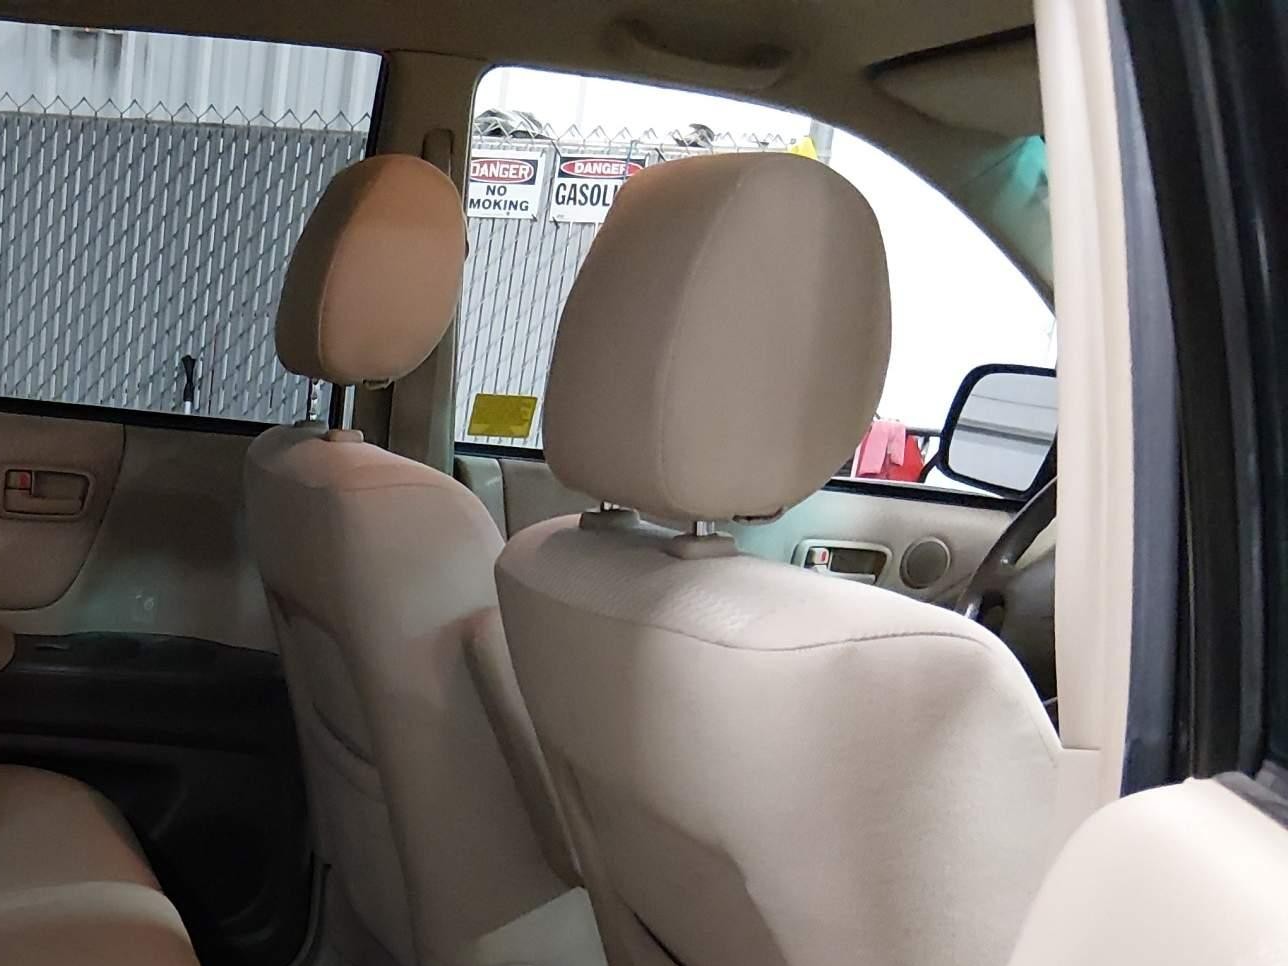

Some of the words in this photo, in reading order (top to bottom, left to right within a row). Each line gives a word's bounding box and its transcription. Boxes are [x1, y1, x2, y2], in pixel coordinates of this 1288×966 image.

[470, 161, 530, 180] DANGER
[485, 184, 508, 197] NO
[468, 198, 530, 212] MOKING
